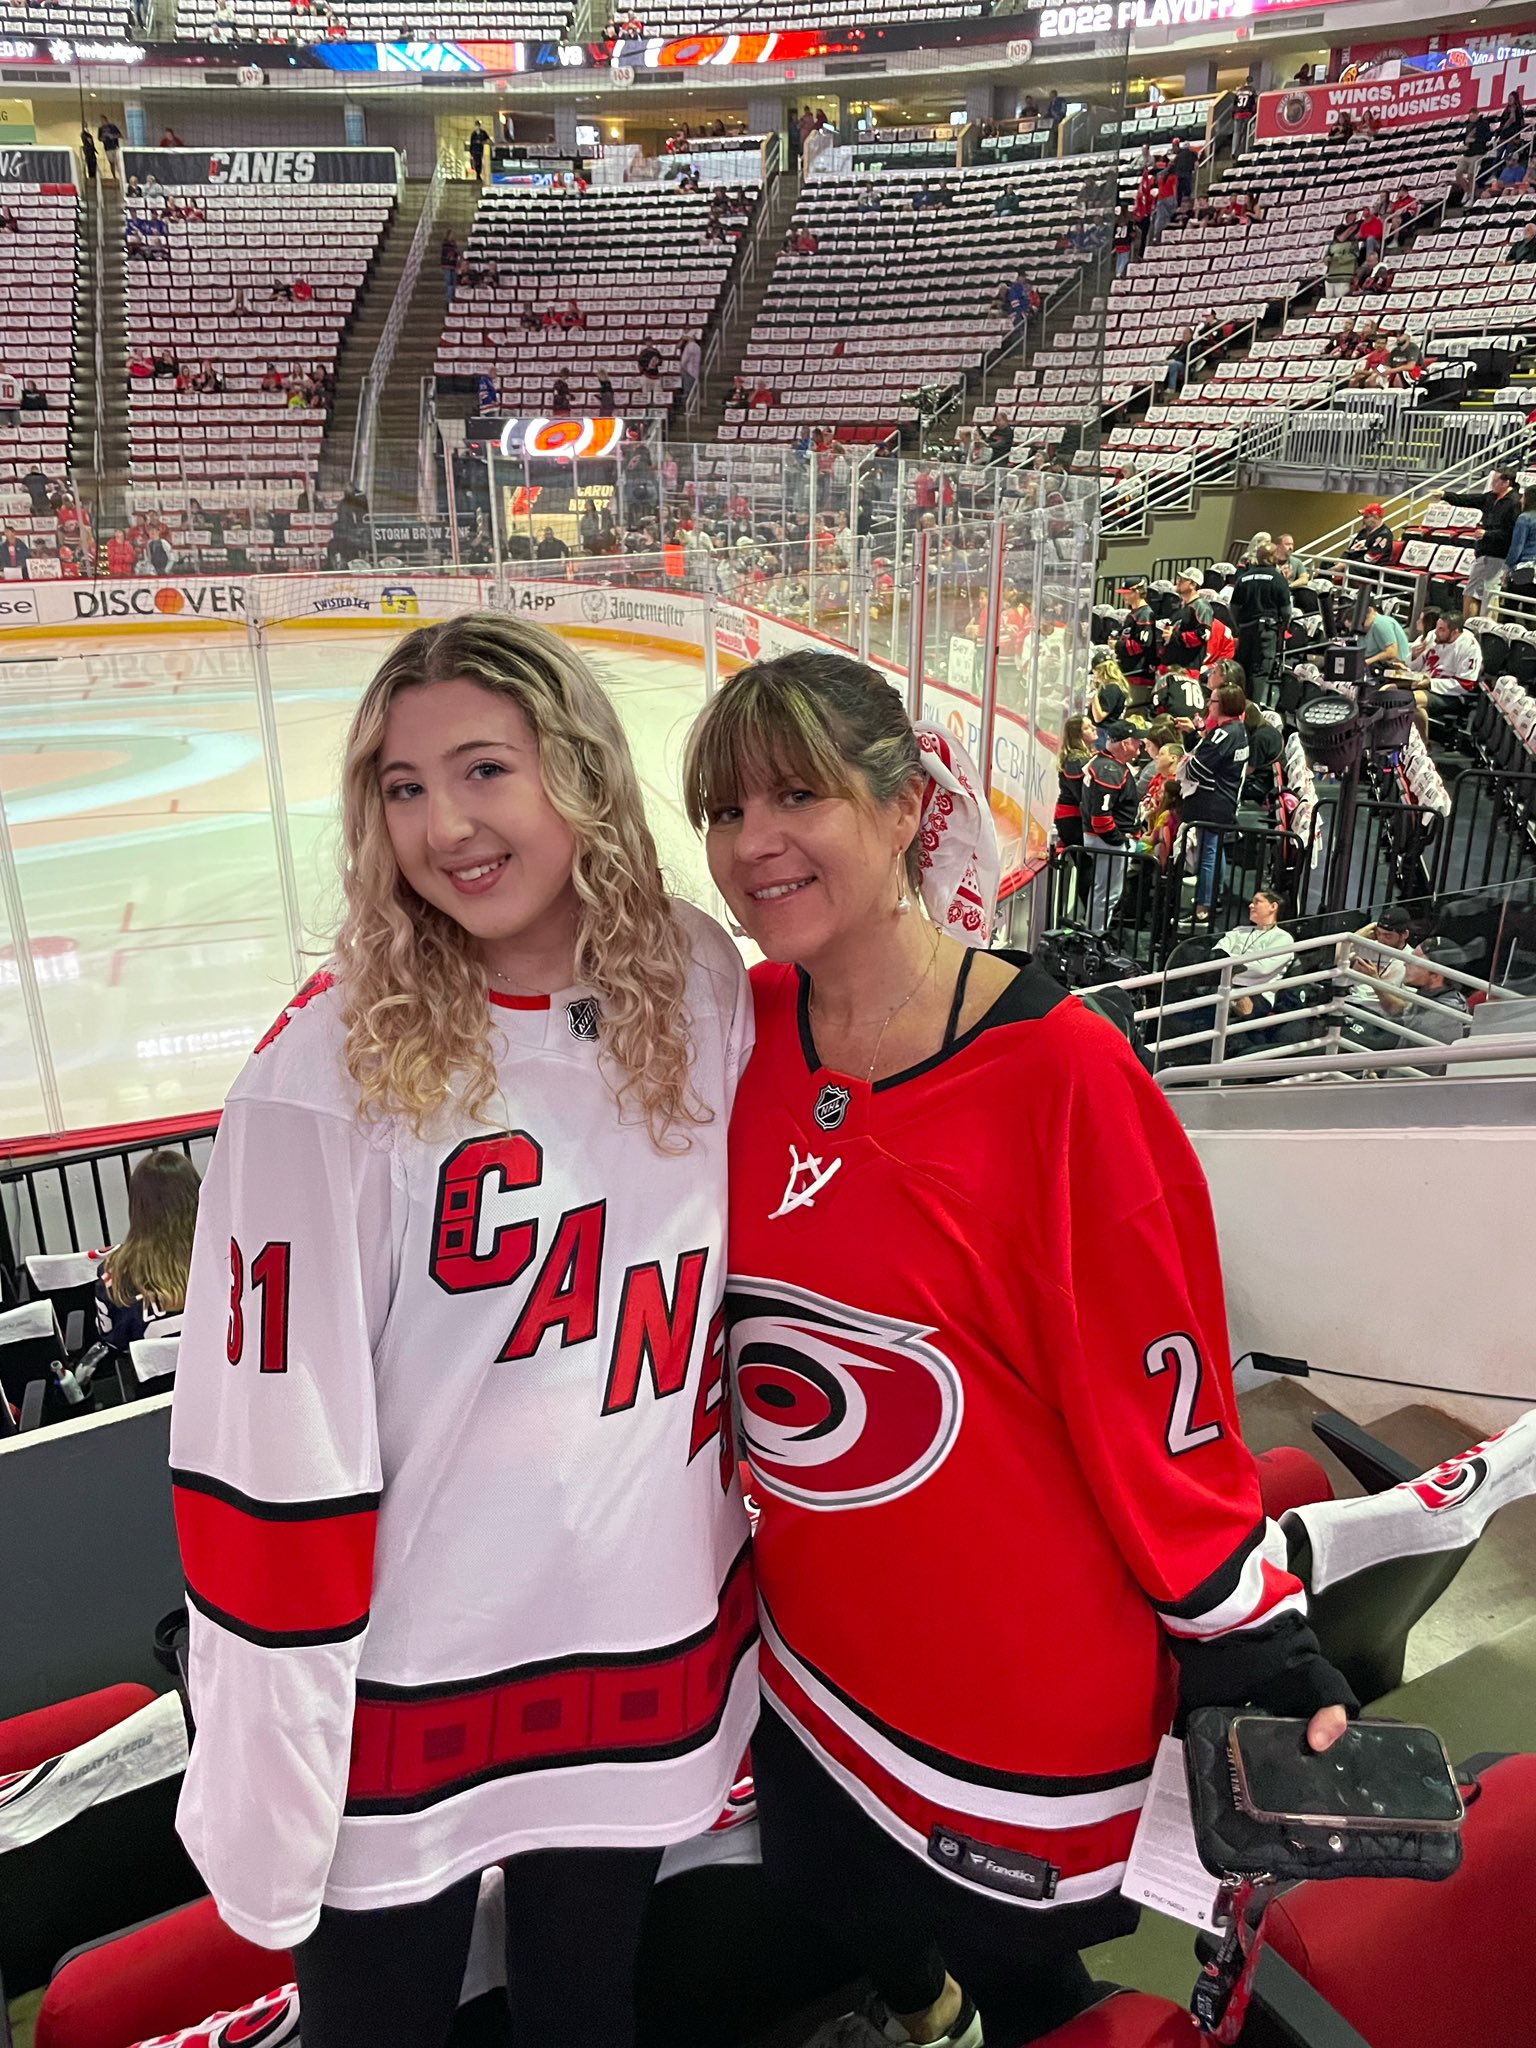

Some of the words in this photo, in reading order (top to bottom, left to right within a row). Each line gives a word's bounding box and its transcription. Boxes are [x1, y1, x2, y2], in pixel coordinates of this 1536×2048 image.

[1040, 4, 1112, 37] 2022
[1329, 84, 1396, 105] WINGS,
[1399, 81, 1444, 99] PIZZA
[1447, 73, 1461, 89] &
[209, 151, 316, 184] CANES
[375, 528, 410, 541] STORM
[445, 526, 471, 539] ZNE
[73, 586, 246, 618] DISCOVER
[1143, 1331, 1224, 1458] 2
[986, 1860, 1036, 1883] Fanatics
